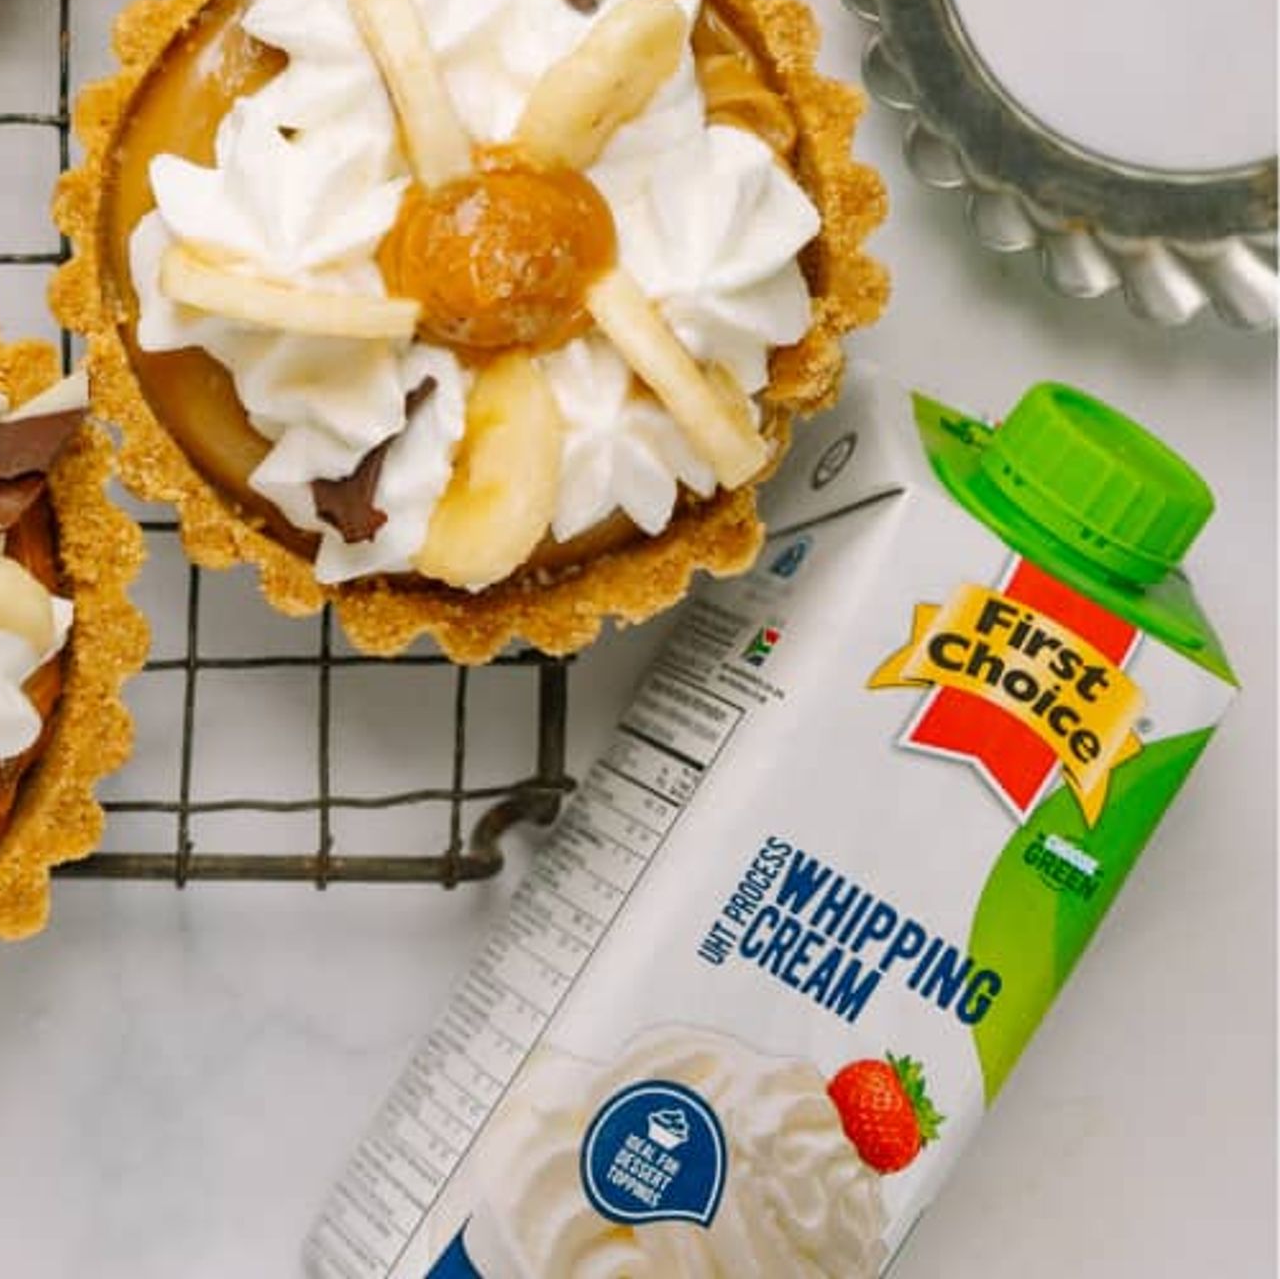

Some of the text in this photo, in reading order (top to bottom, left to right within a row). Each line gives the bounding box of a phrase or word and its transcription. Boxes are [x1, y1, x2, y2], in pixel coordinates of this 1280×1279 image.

[927, 632, 1102, 764] Choice
[975, 598, 1111, 703] First
[698, 836, 792, 966] UHT PROCESS
[1024, 842, 1100, 901] GREEN
[739, 905, 882, 1024] CREAM
[776, 849, 1002, 1025] WHIPPING
[614, 1148, 673, 1191] DESSERT
